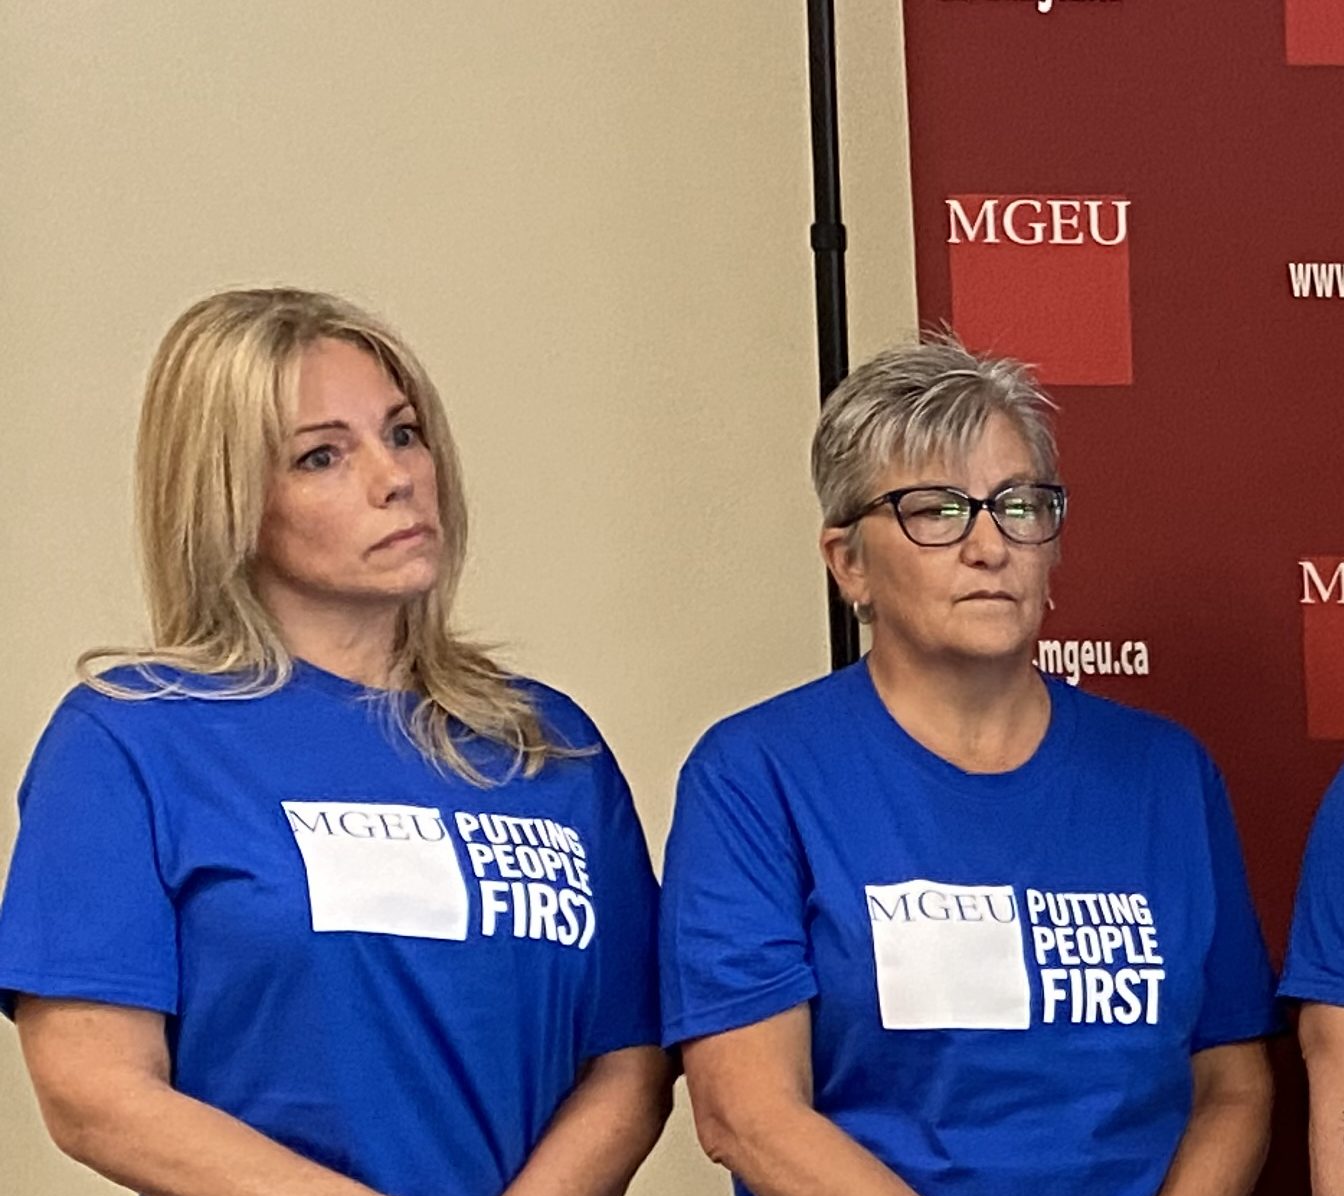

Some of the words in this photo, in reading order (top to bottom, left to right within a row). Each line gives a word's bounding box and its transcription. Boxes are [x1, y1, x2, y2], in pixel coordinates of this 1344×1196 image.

[945, 199, 1131, 245] MGEU
[1031, 639, 1150, 686] .mgeu.ca
[288, 809, 446, 842] MGEU
[454, 811, 587, 859] PUTTING
[466, 843, 593, 896] PEOPLE
[869, 889, 1016, 923] MGEU
[1025, 888, 1154, 927] PUTTING
[1031, 926, 1165, 965] PEOPLE
[1040, 968, 1166, 1025] FIRST
